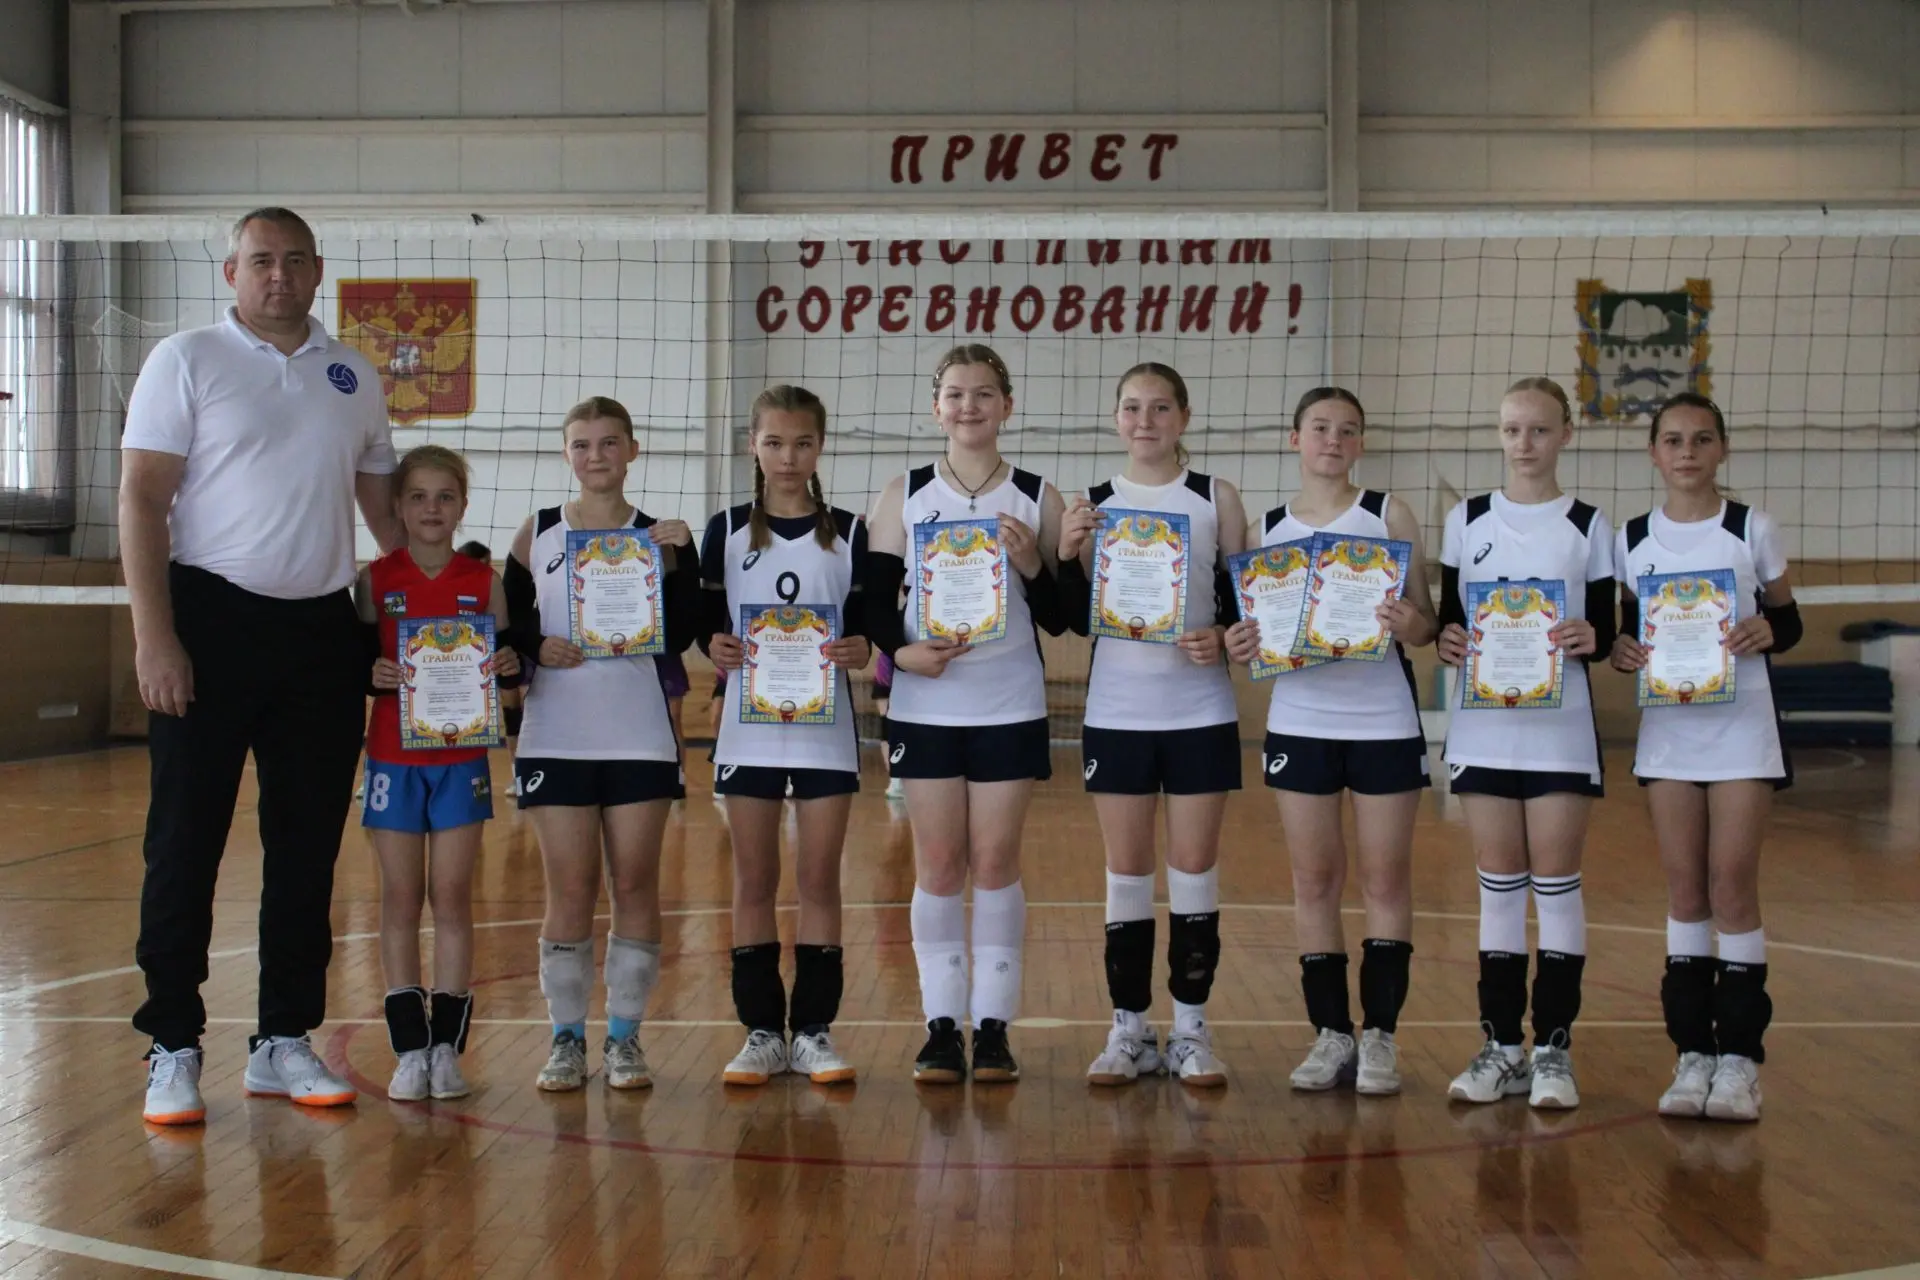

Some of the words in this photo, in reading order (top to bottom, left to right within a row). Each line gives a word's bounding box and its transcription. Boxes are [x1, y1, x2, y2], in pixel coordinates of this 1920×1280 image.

[890, 133, 1178, 184] ПРИВЕТ
[755, 281, 1303, 334] СОРЕВНОВАНИЙ!
[1118, 547, 1166, 558] ГРАМОТА
[939, 559, 985, 567] ГРАМОТА
[591, 567, 638, 576] ГРАМОТА
[1331, 571, 1381, 586] ГРАМОТА
[776, 571, 800, 605] 9
[1258, 576, 1306, 593] ГРАМОТА
[1663, 611, 1712, 623] ГРАМОТА
[1491, 619, 1540, 629] ГРАМОТА
[765, 634, 813, 642] ГРАМОТА
[422, 654, 473, 664] ГРАМОТА
